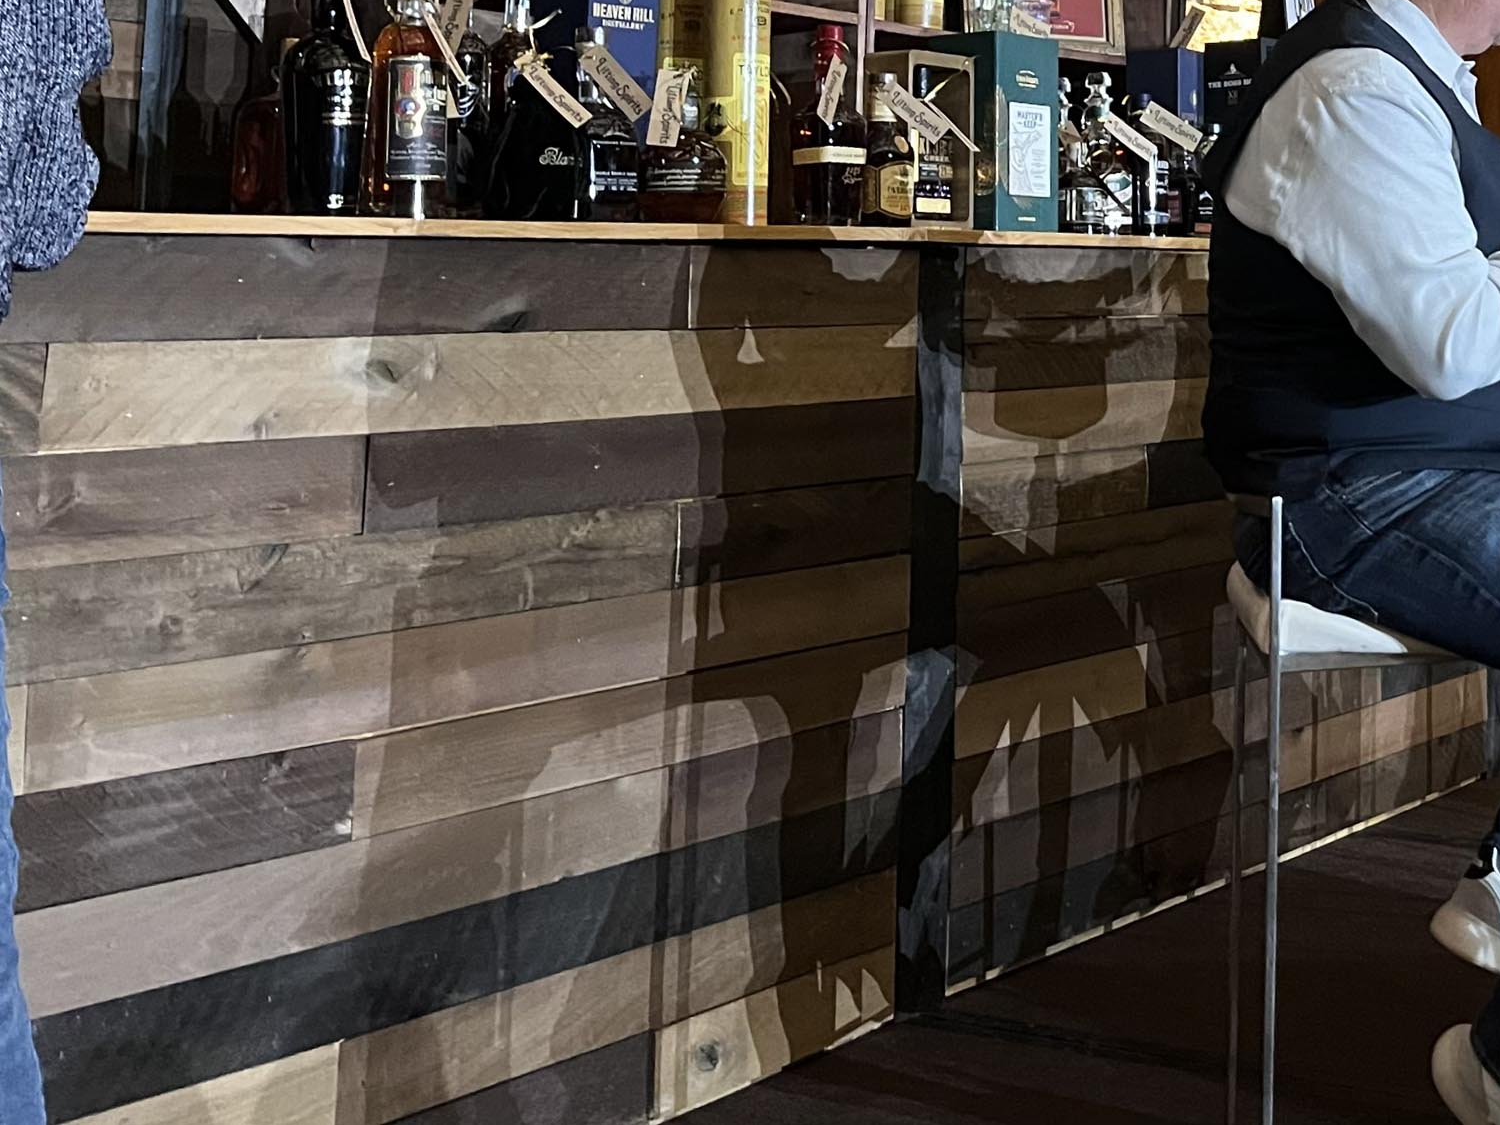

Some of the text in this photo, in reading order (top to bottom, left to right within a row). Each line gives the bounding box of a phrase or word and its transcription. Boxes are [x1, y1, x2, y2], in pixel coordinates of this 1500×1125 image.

[592, 1, 655, 23] HEAVEN HILL
[595, 56, 621, 91] Lifting
[615, 84, 644, 116] Spirits
[893, 91, 941, 138] Lifting Spirits
